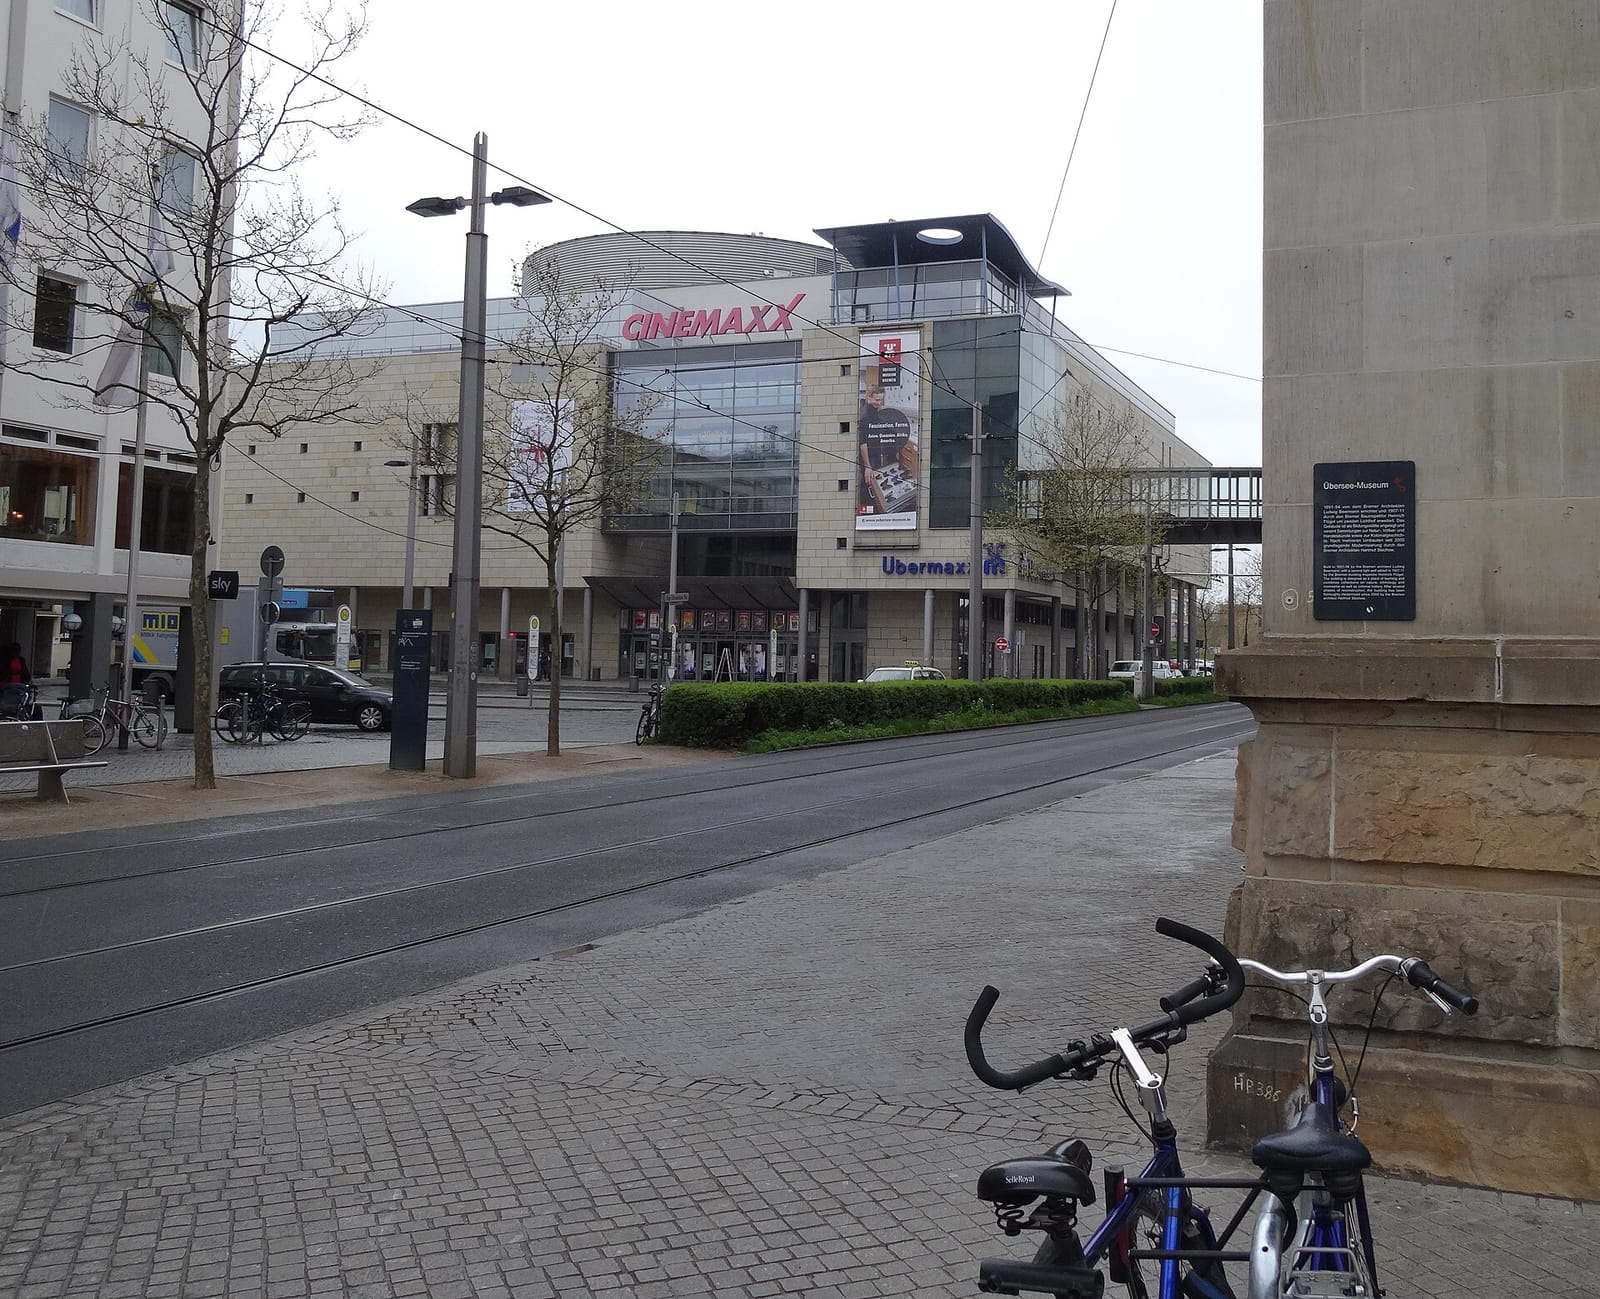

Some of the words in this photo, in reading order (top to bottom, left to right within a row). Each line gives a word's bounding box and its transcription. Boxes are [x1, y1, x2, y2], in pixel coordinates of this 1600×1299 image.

[622, 293, 806, 342] CINEMAXX
[1323, 481, 1389, 490] Übersee-Museum
[211, 577, 232, 592] sky
